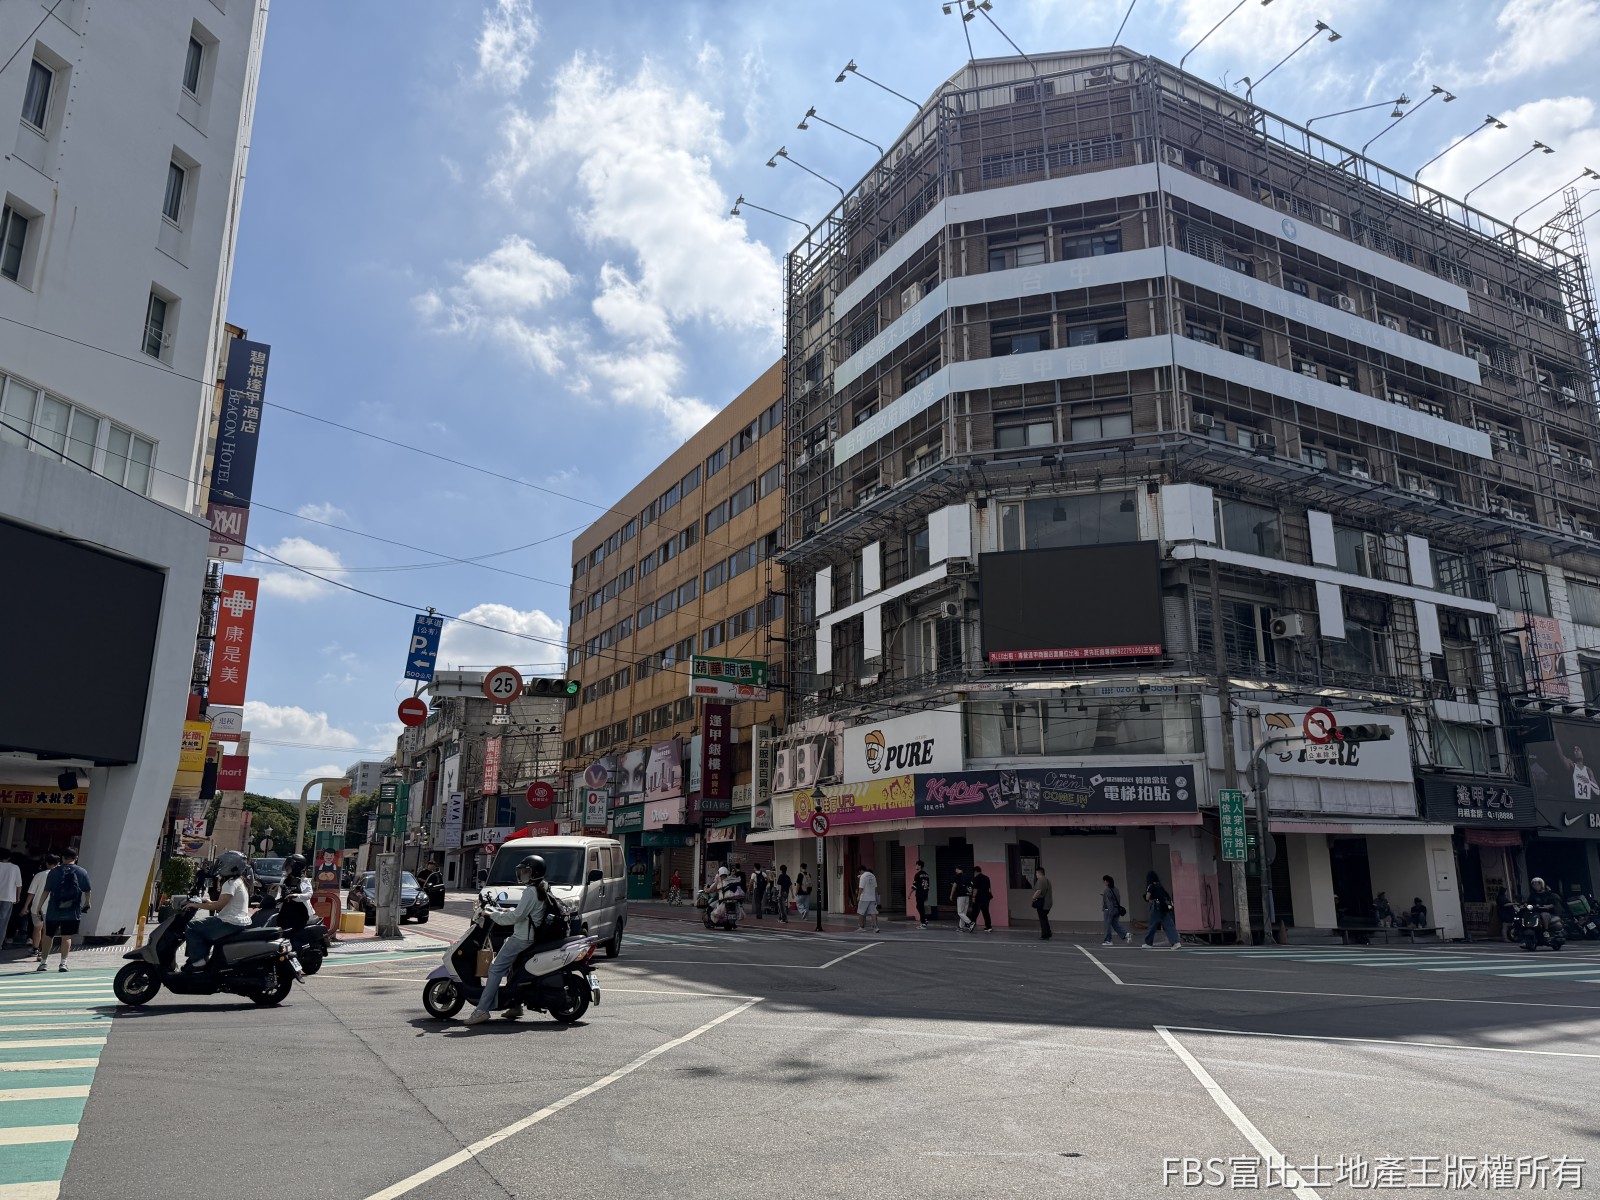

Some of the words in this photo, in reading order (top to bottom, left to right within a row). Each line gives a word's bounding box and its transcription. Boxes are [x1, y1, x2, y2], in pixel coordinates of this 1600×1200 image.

[1021, 262, 1092, 293] 台中
[998, 347, 1126, 383] 逢甲商圈
[240, 350, 266, 434] 碧根逢甲酒店
[224, 388, 241, 439] BEACON
[217, 440, 236, 485] HOTEL
[218, 546, 229, 557] P
[220, 625, 243, 684] 康是美
[410, 635, 428, 654] P
[406, 670, 432, 680] 500公尺
[694, 661, 752, 678] 精華眼鏡
[493, 677, 513, 693] 25
[708, 714, 723, 771] 逢甲銀樓
[884, 738, 935, 771] PURE
[1308, 751, 1338, 759] 公車除外
[588, 793, 605, 804] 0元
[838, 793, 855, 808] UFO
[1103, 785, 1171, 802] 電梯拍貼
[1456, 785, 1514, 808] 逢甲之心
[1577, 783, 1588, 797] 34
[320, 792, 335, 829] 大逢甲
[588, 806, 604, 814] 鏡片
[702, 800, 720, 809] GIA
[332, 812, 346, 836] 商圈
[1221, 791, 1234, 859] 請依燈號行止
[1231, 791, 1245, 859] 行人穿越路口
